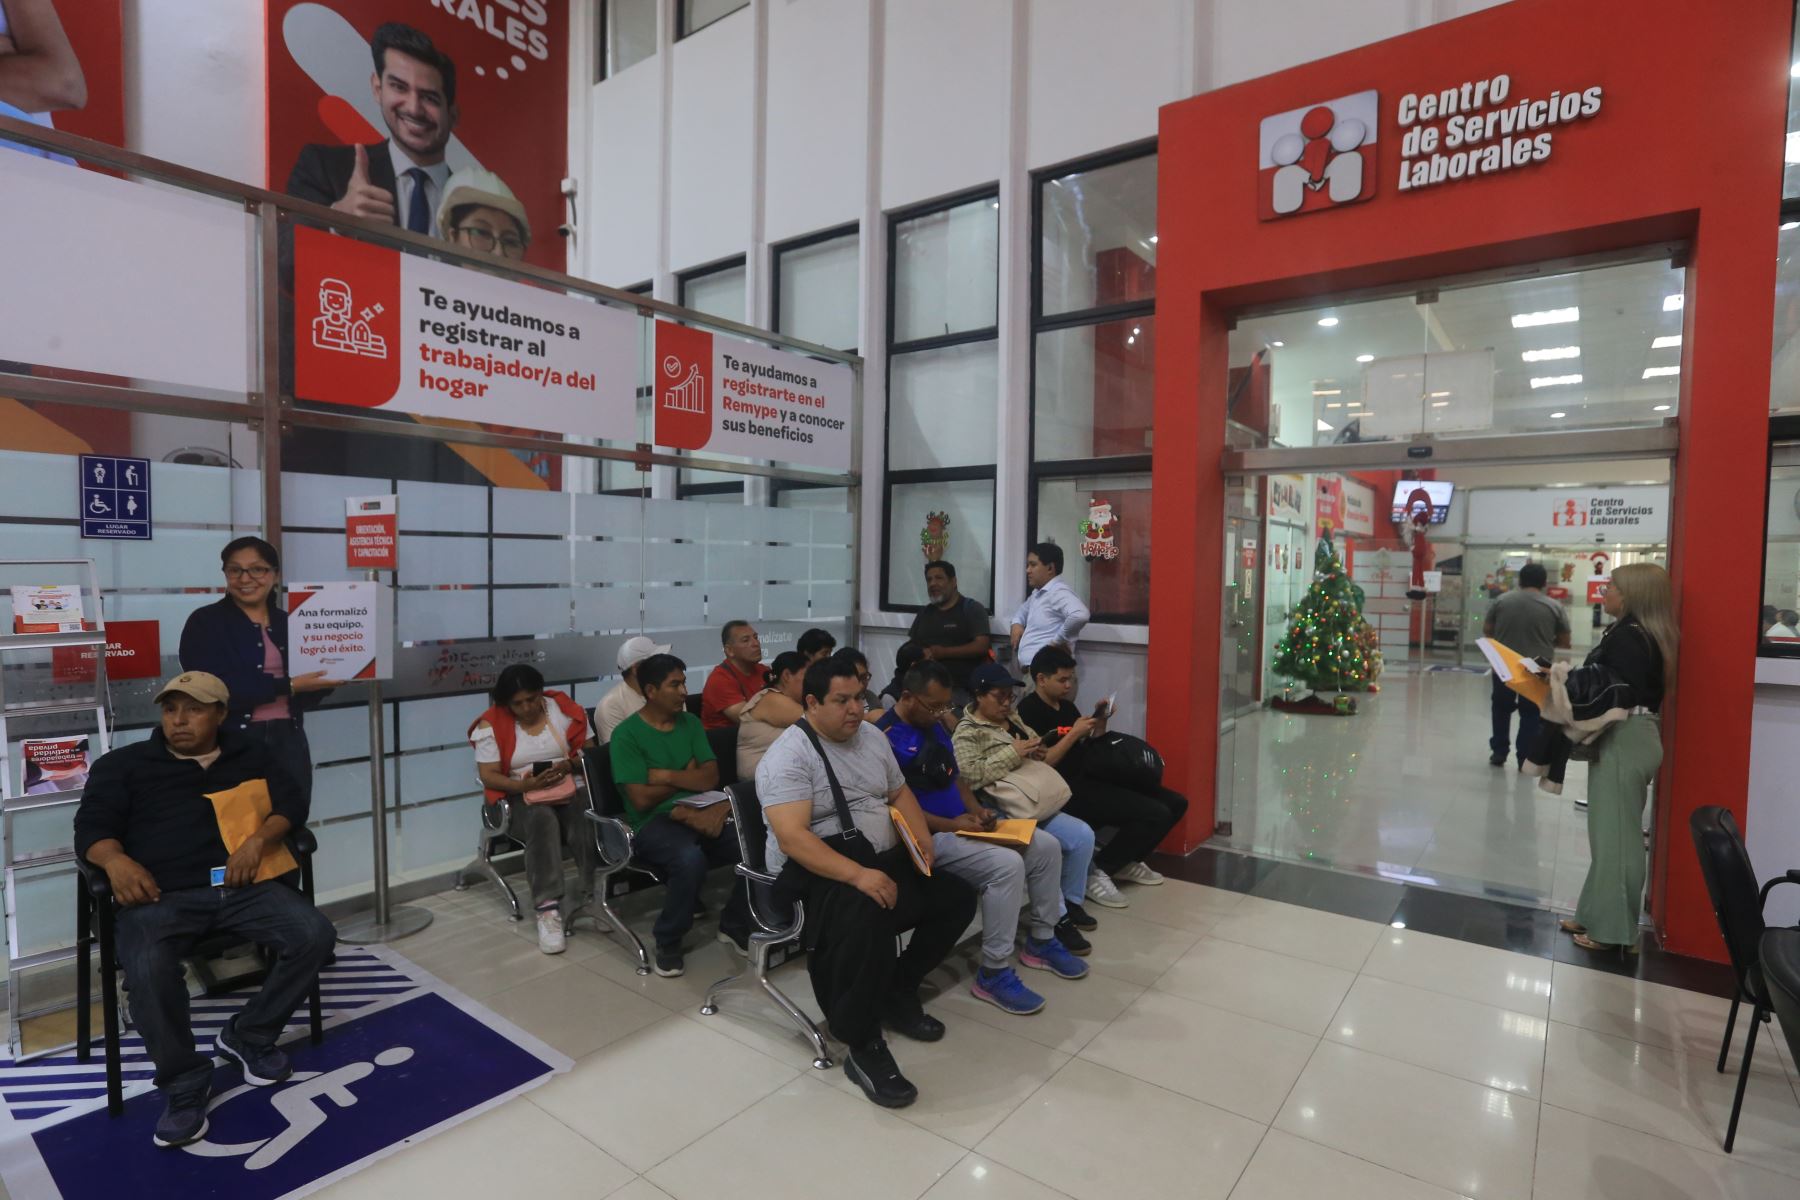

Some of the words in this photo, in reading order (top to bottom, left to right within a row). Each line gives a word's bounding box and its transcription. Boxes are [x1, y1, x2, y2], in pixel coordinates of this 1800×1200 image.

[1398, 74, 1510, 126] Centro
[1402, 125, 1439, 158] de
[1445, 86, 1602, 148] Servicios
[1398, 132, 1552, 191] Laborales
[419, 287, 448, 310] Te
[452, 299, 565, 337] ayudamos
[569, 326, 580, 340] a
[419, 318, 524, 352] registrar
[527, 339, 545, 357] al
[419, 343, 562, 387] trabajador/a
[566, 370, 595, 391] del
[419, 367, 489, 399] hogar
[723, 354, 739, 371] Te
[742, 362, 808, 386] ayudamos
[809, 378, 817, 388] a
[723, 377, 796, 403] registrarte
[798, 394, 812, 406] en
[815, 395, 825, 409] el
[722, 396, 777, 420] Remype
[780, 409, 787, 423] y
[789, 411, 797, 422] a
[800, 413, 845, 430] conocer
[722, 419, 746, 433] sus
[748, 419, 814, 444] beneficios
[1590, 507, 1603, 516] de
[1605, 506, 1653, 516] Servicios
[1591, 498, 1624, 507] Centro
[1590, 516, 1640, 526] Laborales
[297, 609, 318, 617] Ana
[320, 607, 368, 617] formalizó
[313, 622, 325, 630] su
[300, 645, 327, 656] logró
[328, 644, 337, 654] el
[338, 643, 366, 653] éxito.
[303, 634, 309, 643] y
[311, 633, 323, 641] su
[324, 631, 364, 642] negocio
[33, 748, 70, 757] actividad
